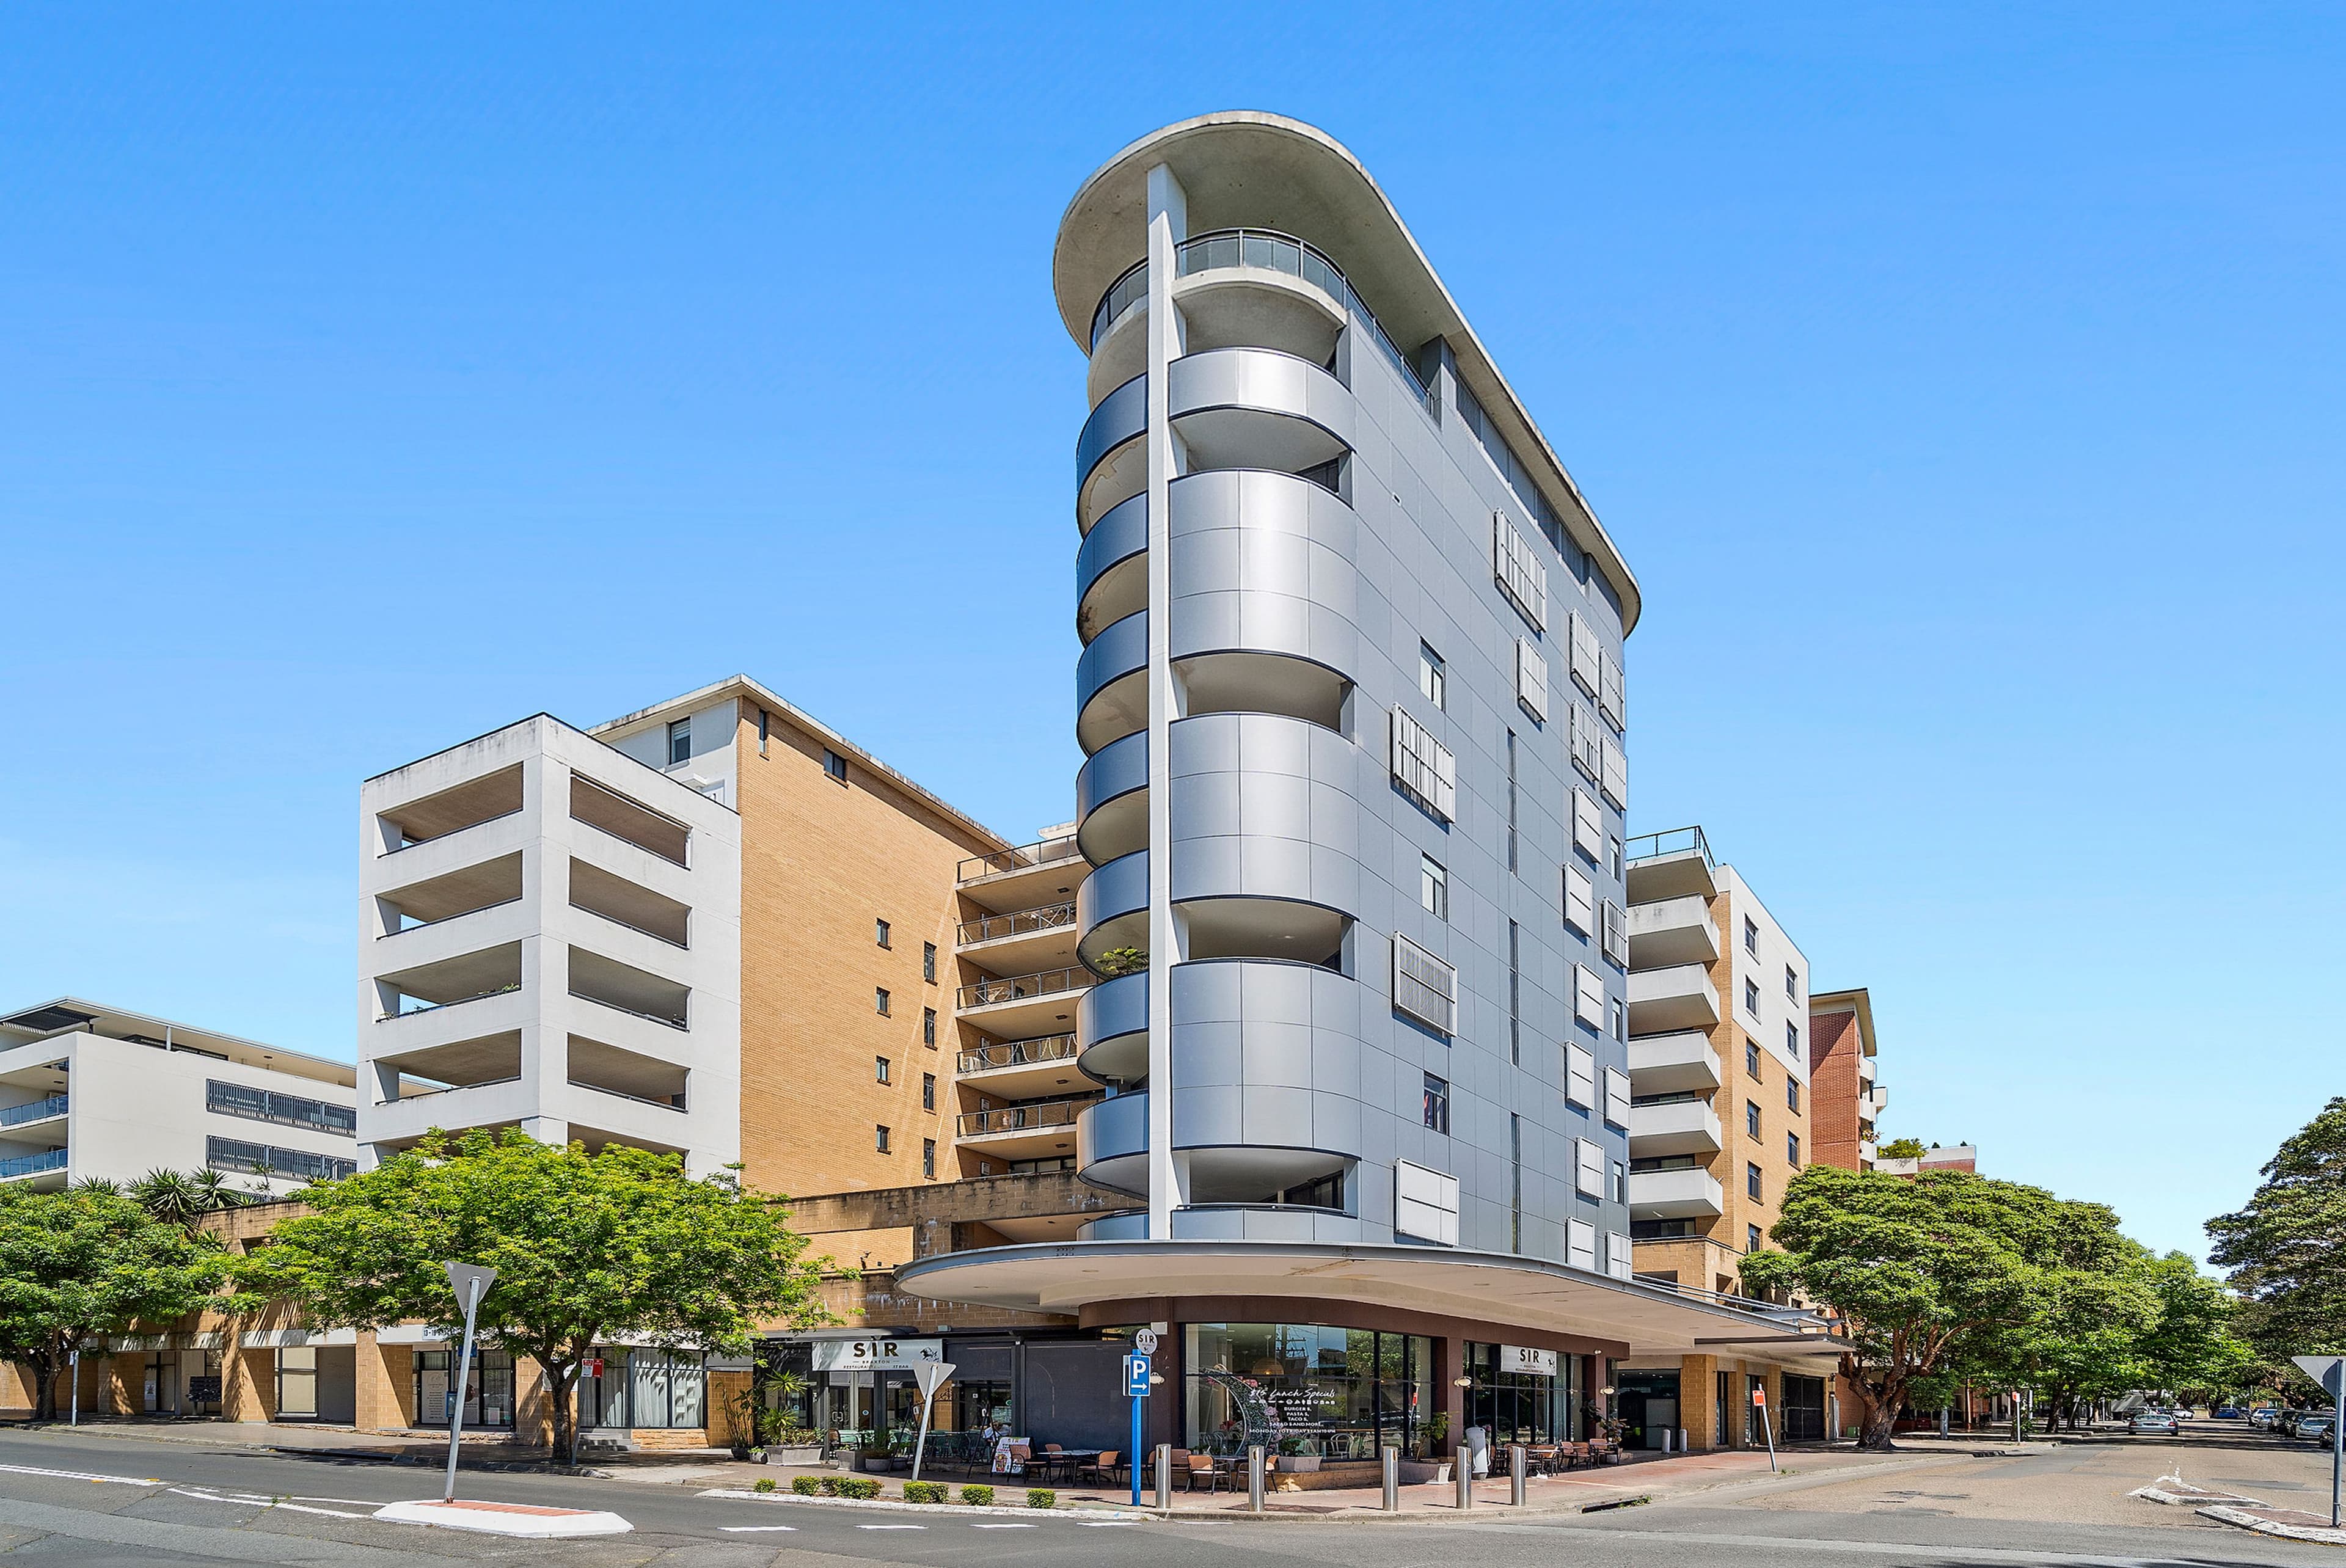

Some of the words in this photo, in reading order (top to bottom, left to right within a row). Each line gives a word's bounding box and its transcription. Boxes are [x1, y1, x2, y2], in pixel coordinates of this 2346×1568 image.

[1139, 1335, 1155, 1343] SIR
[853, 1342, 900, 1357] SIR
[1519, 1348, 1540, 1363] SIR
[1133, 1360, 1147, 1379] P
[1270, 1388, 1303, 1397] Lunch
[1303, 1388, 1336, 1399] Specials
